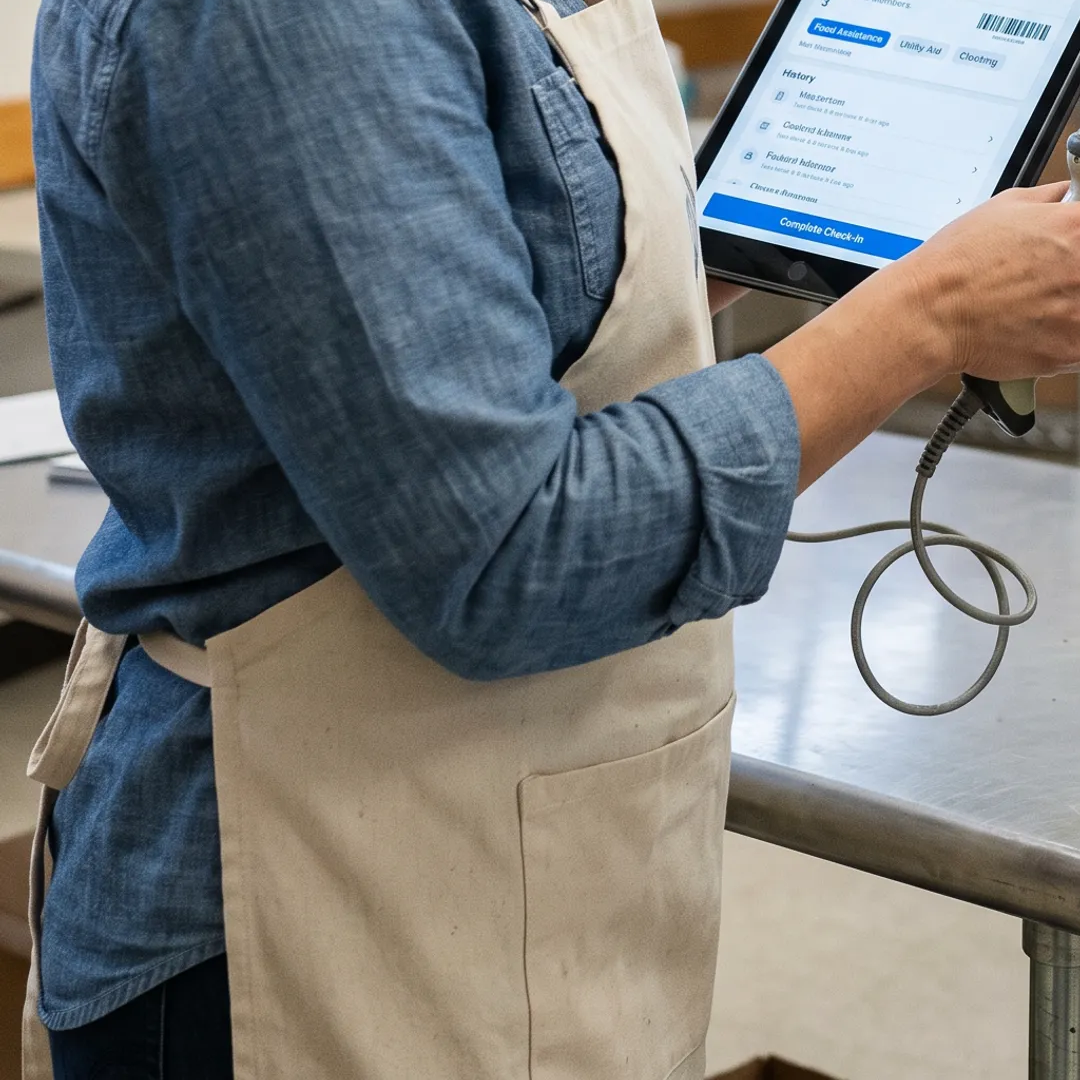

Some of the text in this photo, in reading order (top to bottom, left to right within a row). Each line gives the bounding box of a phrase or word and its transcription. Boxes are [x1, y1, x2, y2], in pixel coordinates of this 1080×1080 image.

[814, 22, 836, 34] Food
[925, 45, 943, 56] Aid
[780, 217, 864, 245] Complete Check-in
